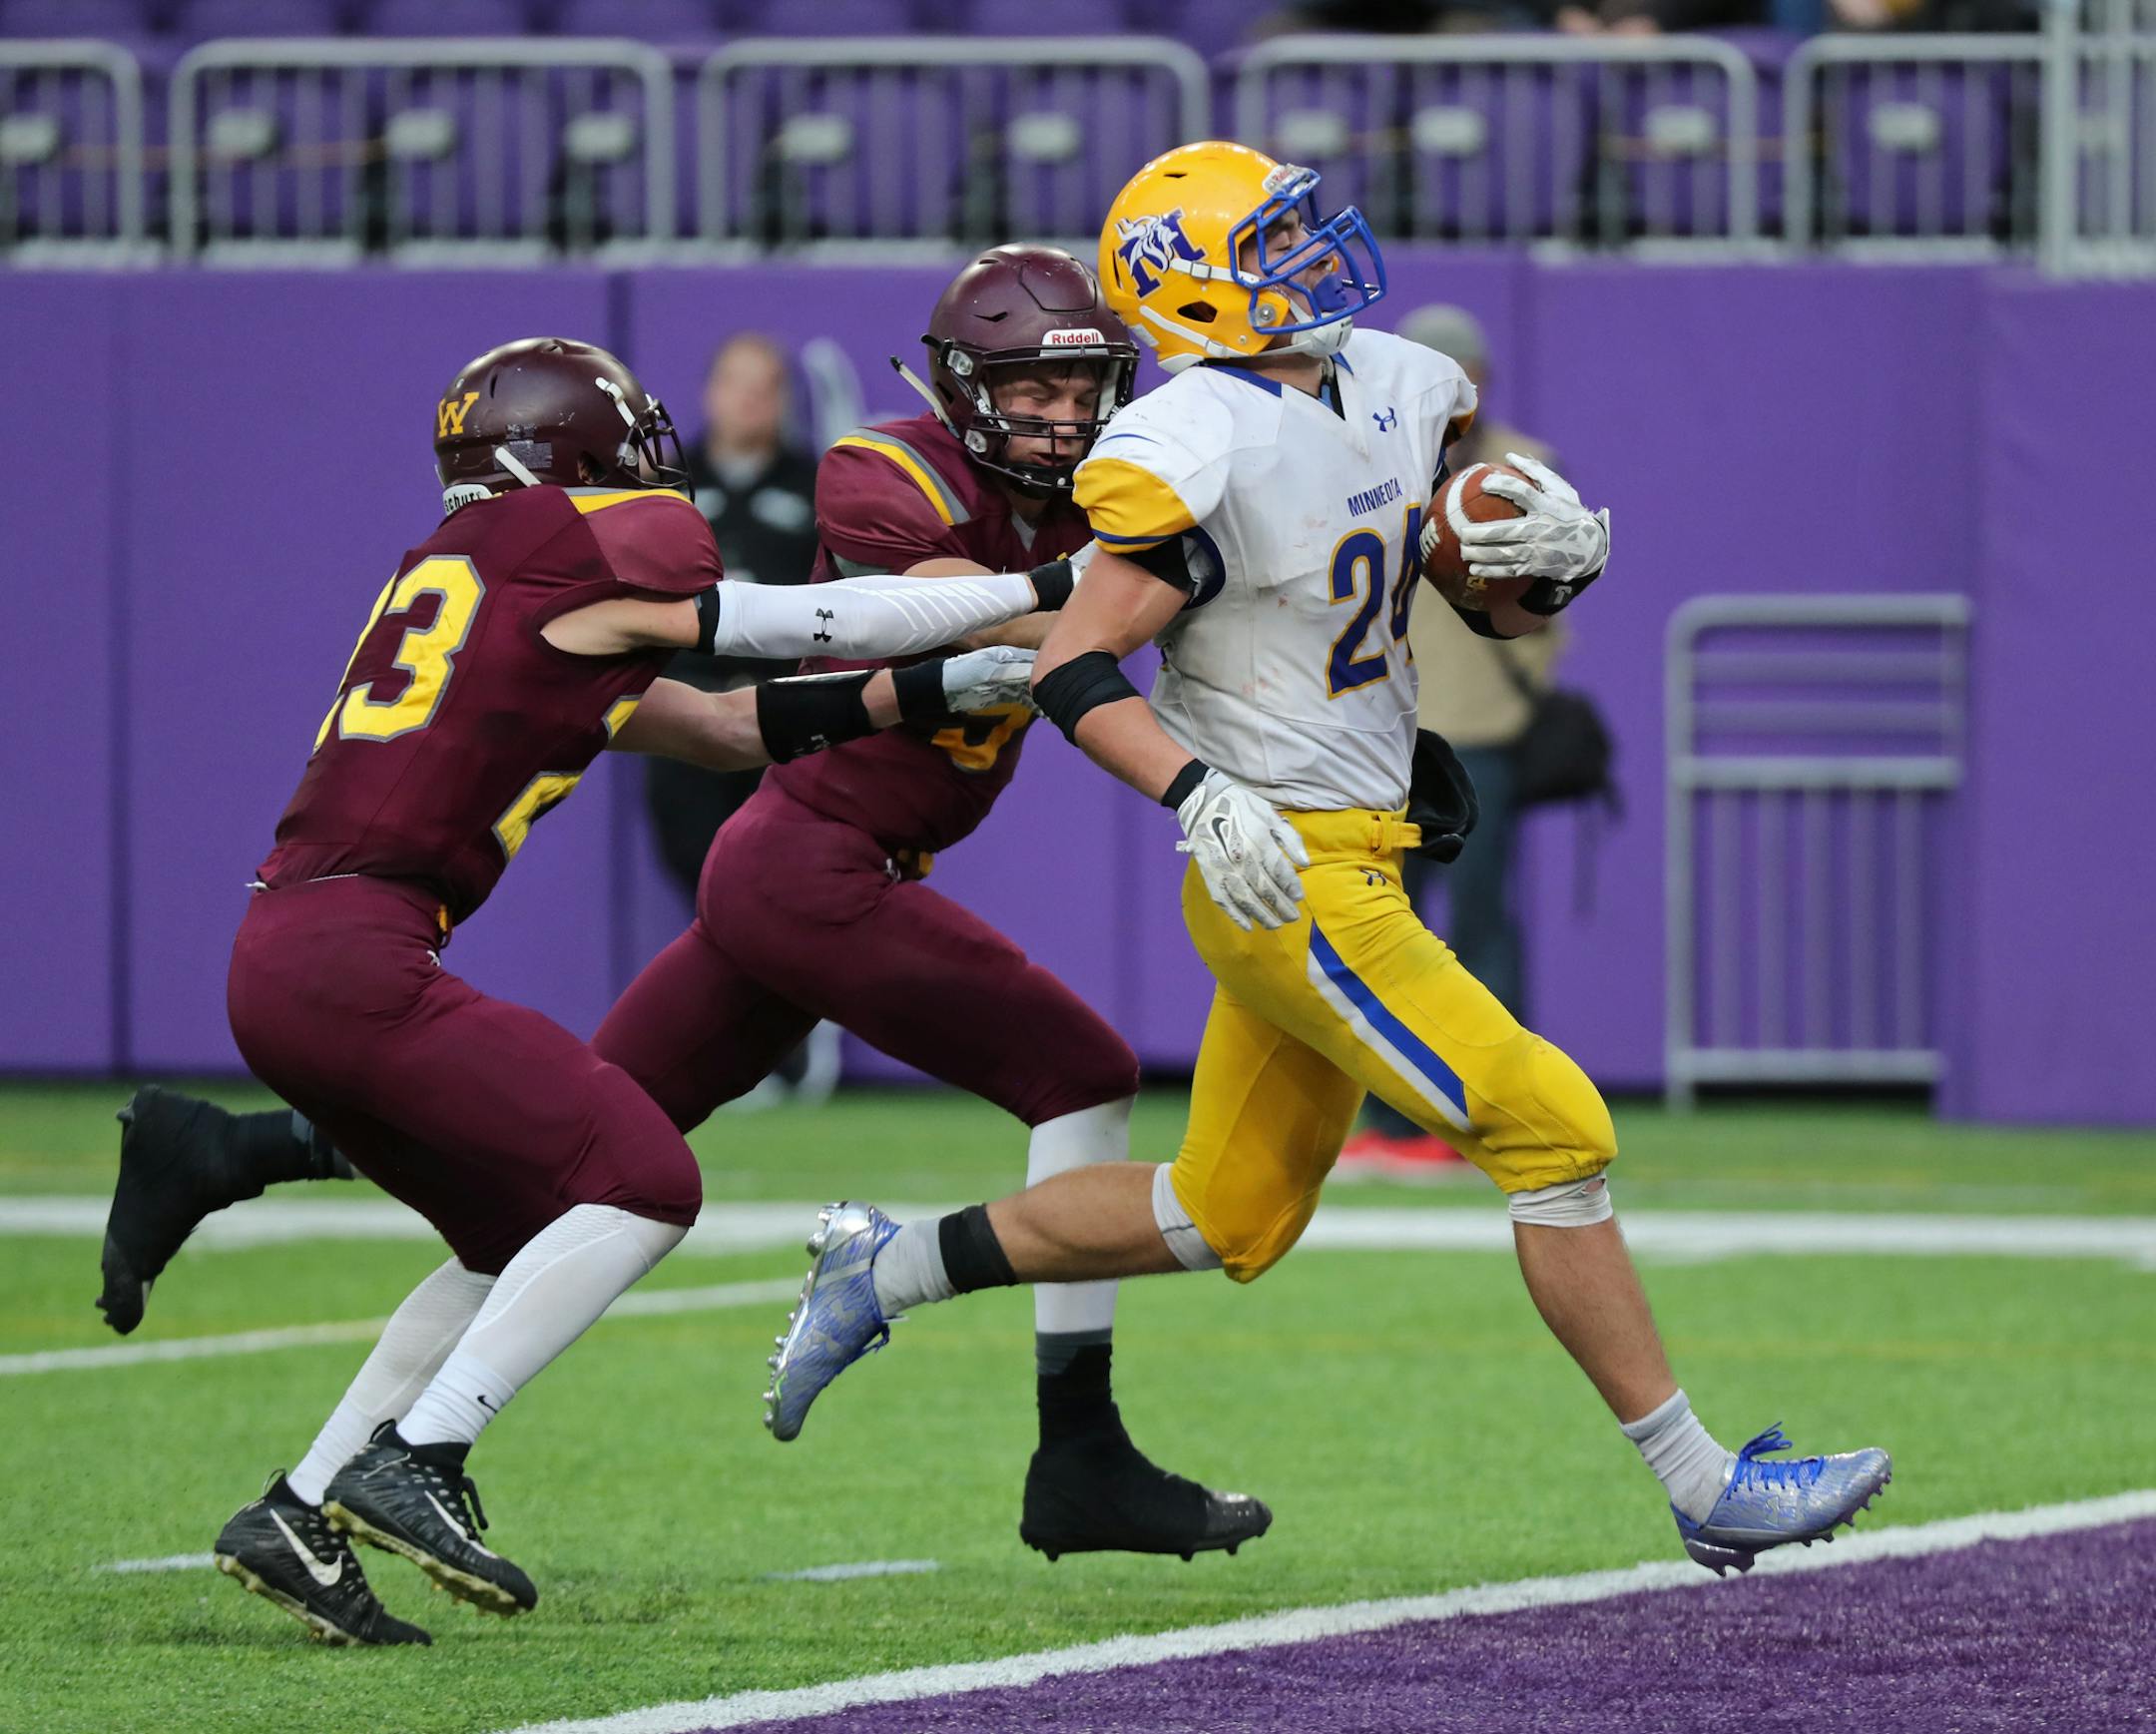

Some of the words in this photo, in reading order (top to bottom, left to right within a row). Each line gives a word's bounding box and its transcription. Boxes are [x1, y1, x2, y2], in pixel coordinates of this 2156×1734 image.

[1051, 331, 1099, 343] Riddell
[438, 391, 480, 438] W
[1348, 477, 1403, 517] MINNEOTA
[1326, 501, 1421, 700] 24
[312, 554, 487, 756] 3
